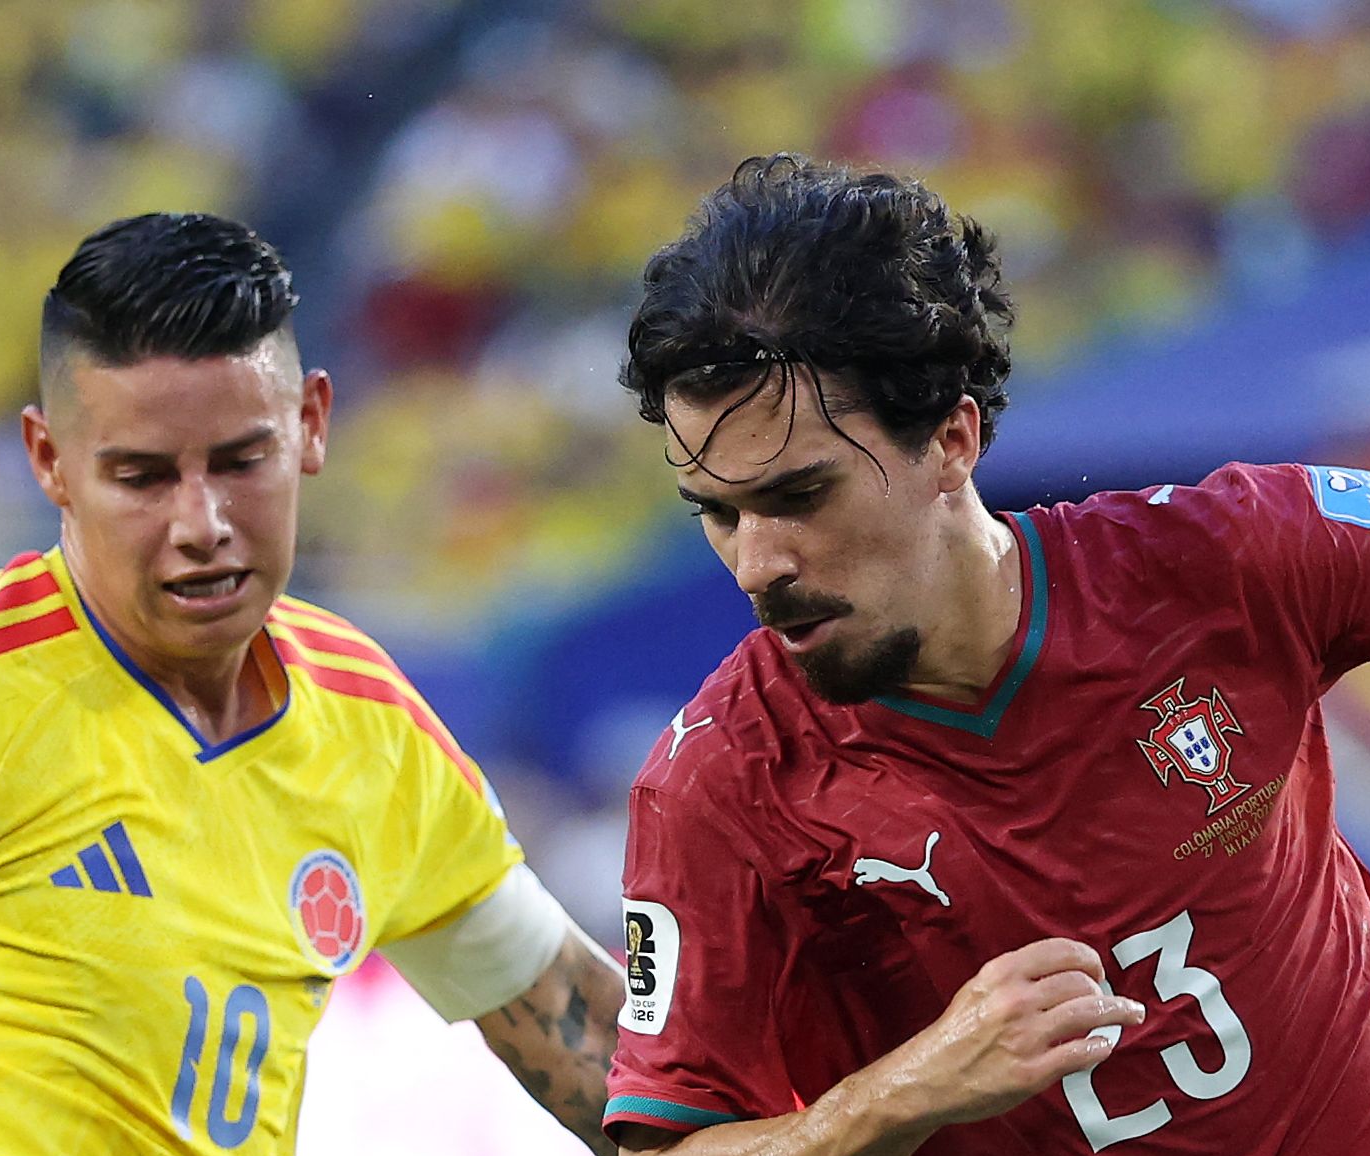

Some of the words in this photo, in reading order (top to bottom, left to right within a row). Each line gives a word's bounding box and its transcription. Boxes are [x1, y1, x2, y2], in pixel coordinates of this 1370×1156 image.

[1201, 843, 1213, 858] 27
[1224, 823, 1263, 857] MIAMI
[632, 1009, 655, 1022] 026
[1062, 909, 1252, 1154] 23
[170, 975, 271, 1150] 10
